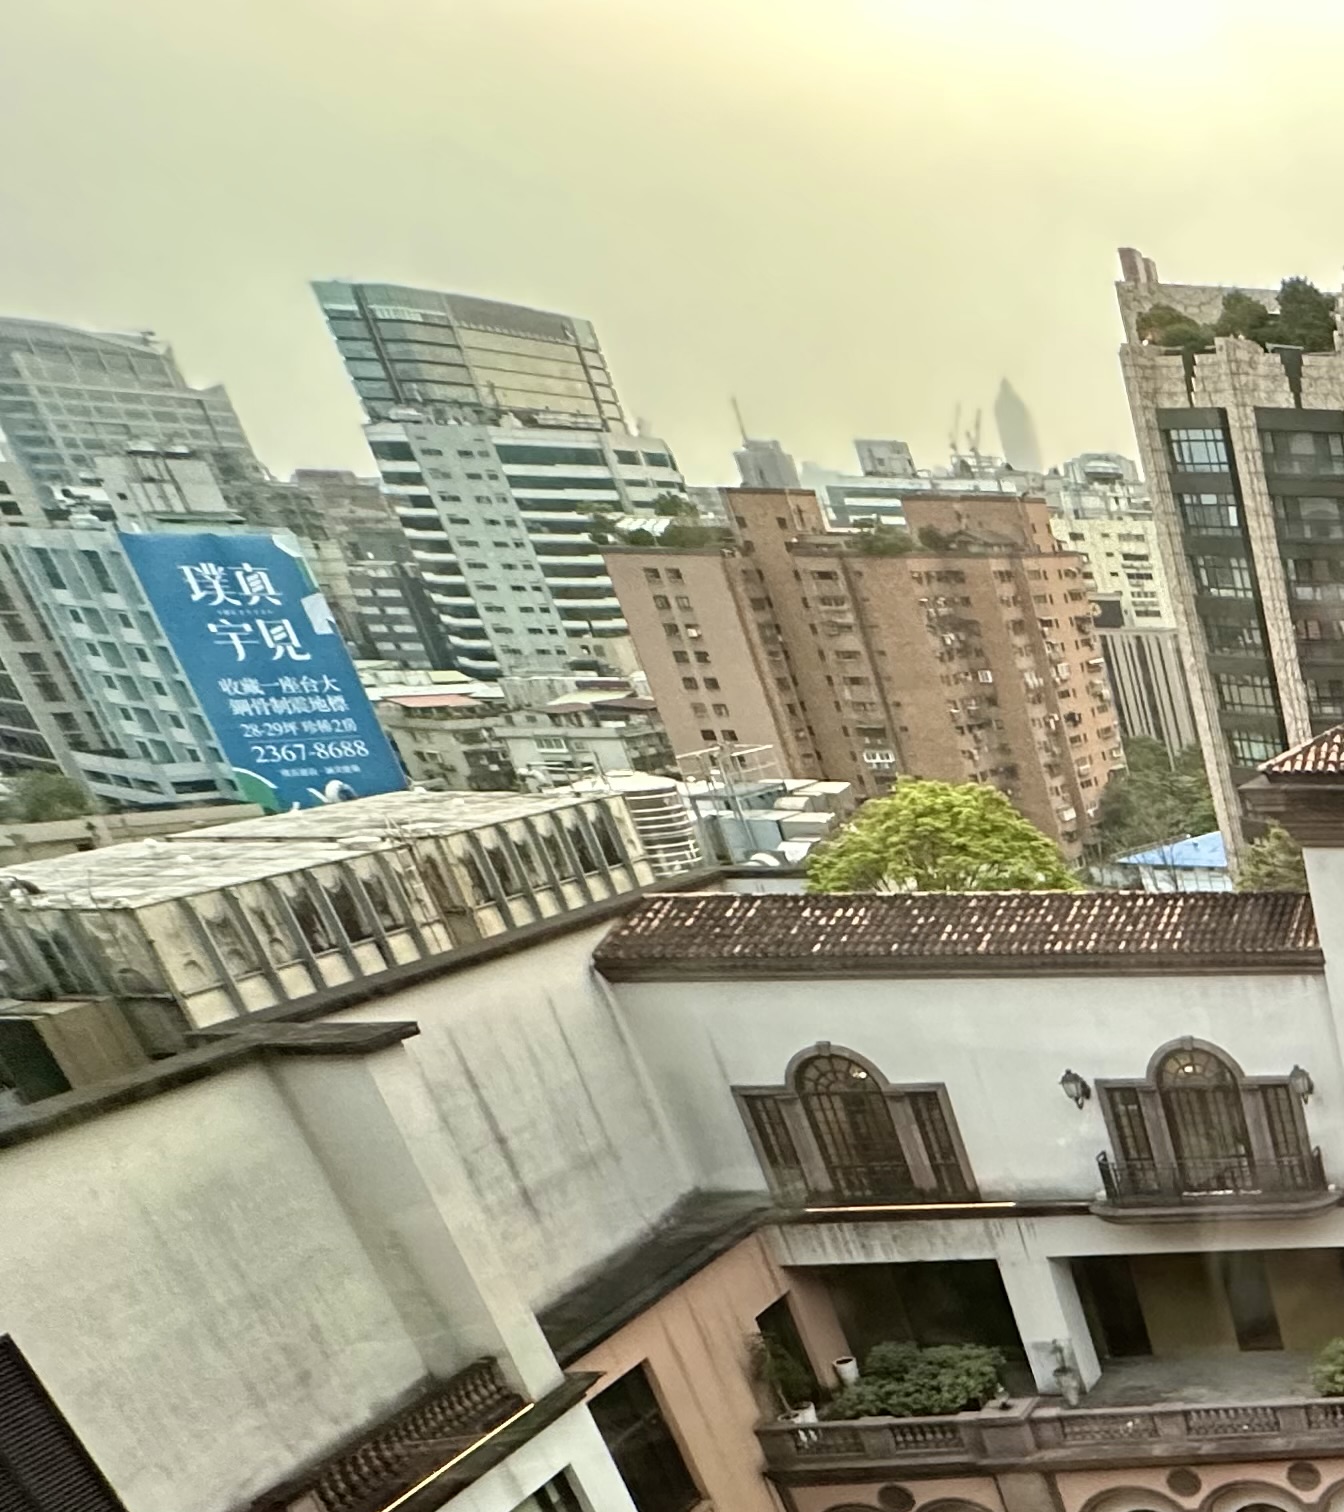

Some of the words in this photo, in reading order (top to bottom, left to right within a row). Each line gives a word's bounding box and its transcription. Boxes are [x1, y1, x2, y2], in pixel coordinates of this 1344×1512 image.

[176, 562, 284, 606] 璞真
[206, 618, 312, 662] 宇見
[218, 674, 342, 696] 收藏一座台大
[250, 740, 370, 763] 2367-8688
